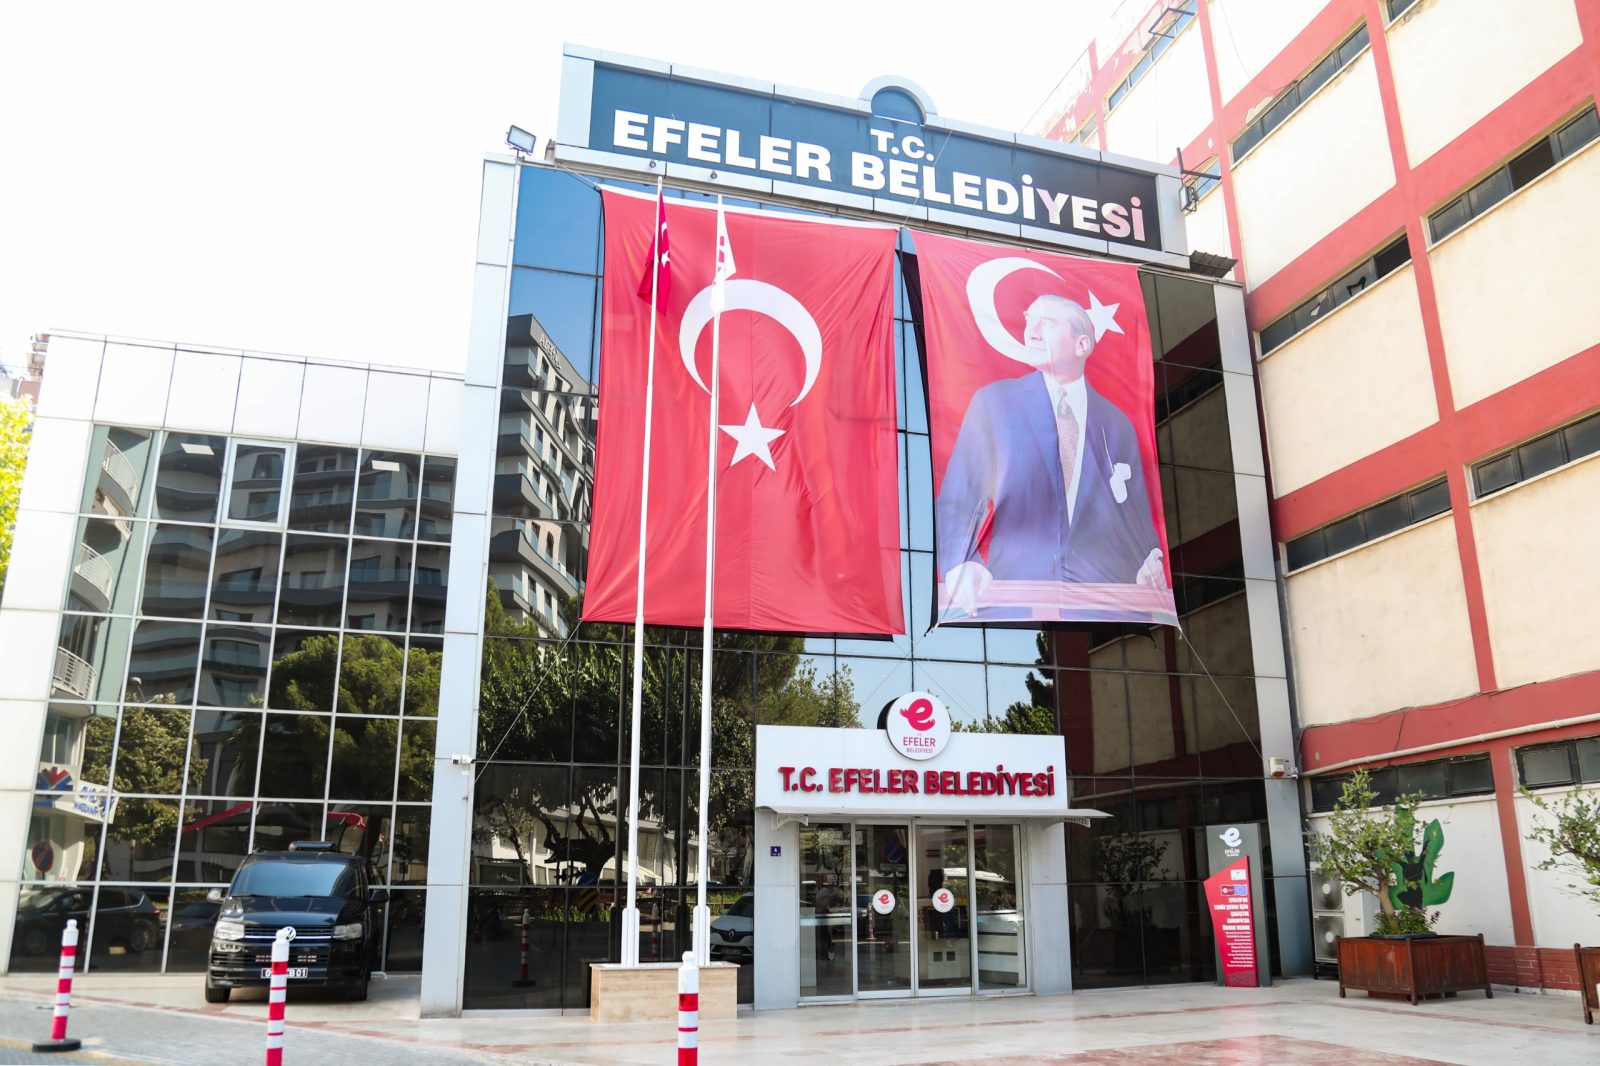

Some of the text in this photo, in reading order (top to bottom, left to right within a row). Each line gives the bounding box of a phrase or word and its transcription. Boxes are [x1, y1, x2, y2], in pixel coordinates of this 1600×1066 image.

[870, 128, 935, 162] T.C.
[613, 109, 1146, 242] EFELER BELEDİYESİ
[903, 736, 936, 747] EFELER
[778, 764, 1055, 797] T.C. EFELER BELEDİYESİ
